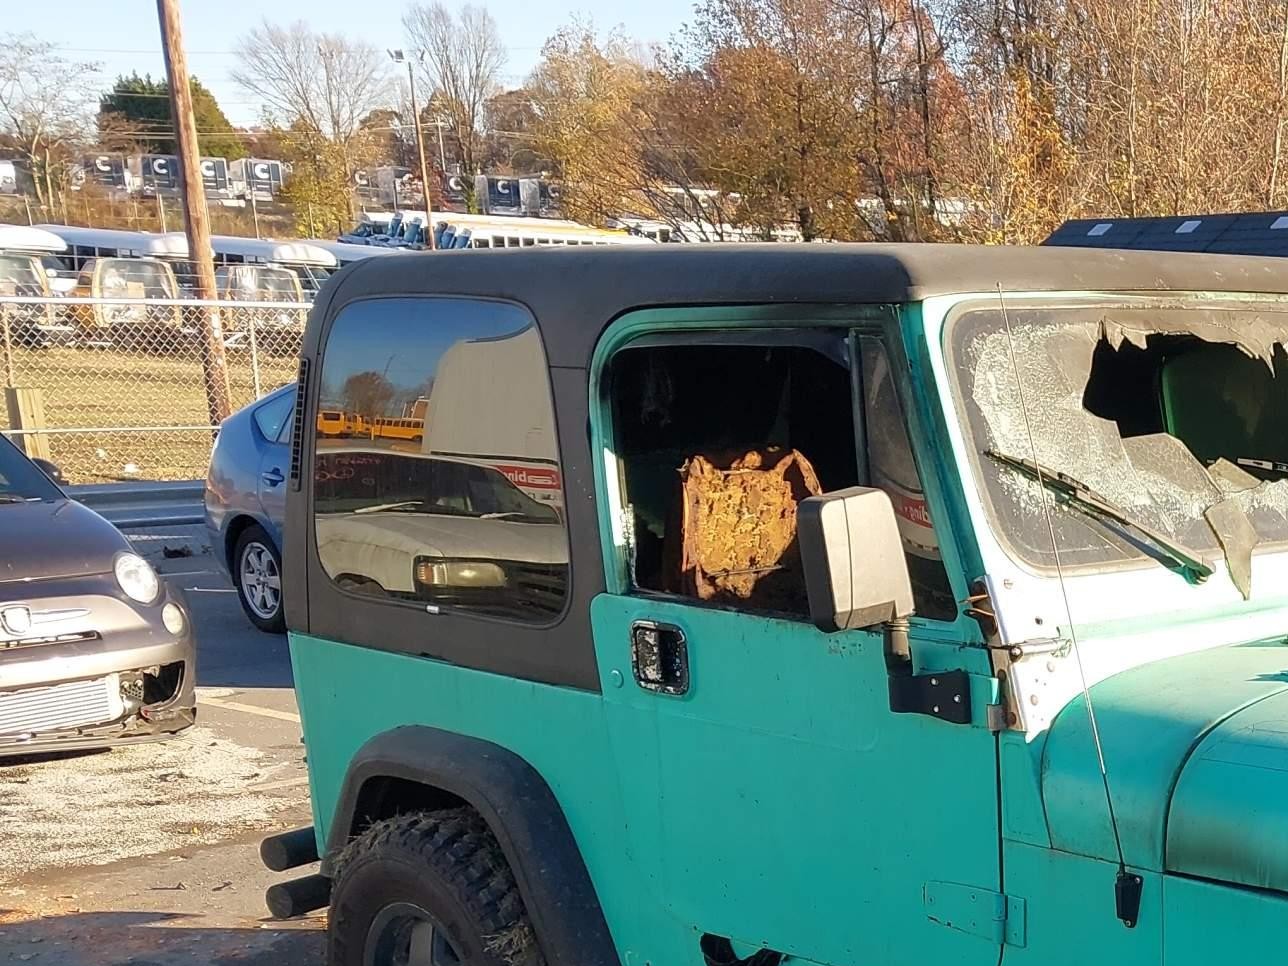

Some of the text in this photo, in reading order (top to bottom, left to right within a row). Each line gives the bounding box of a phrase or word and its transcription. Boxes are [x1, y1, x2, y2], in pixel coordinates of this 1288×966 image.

[153, 158, 169, 174] C
[200, 160, 216, 177] C
[254, 163, 270, 179] C
[496, 180, 511, 194] C
